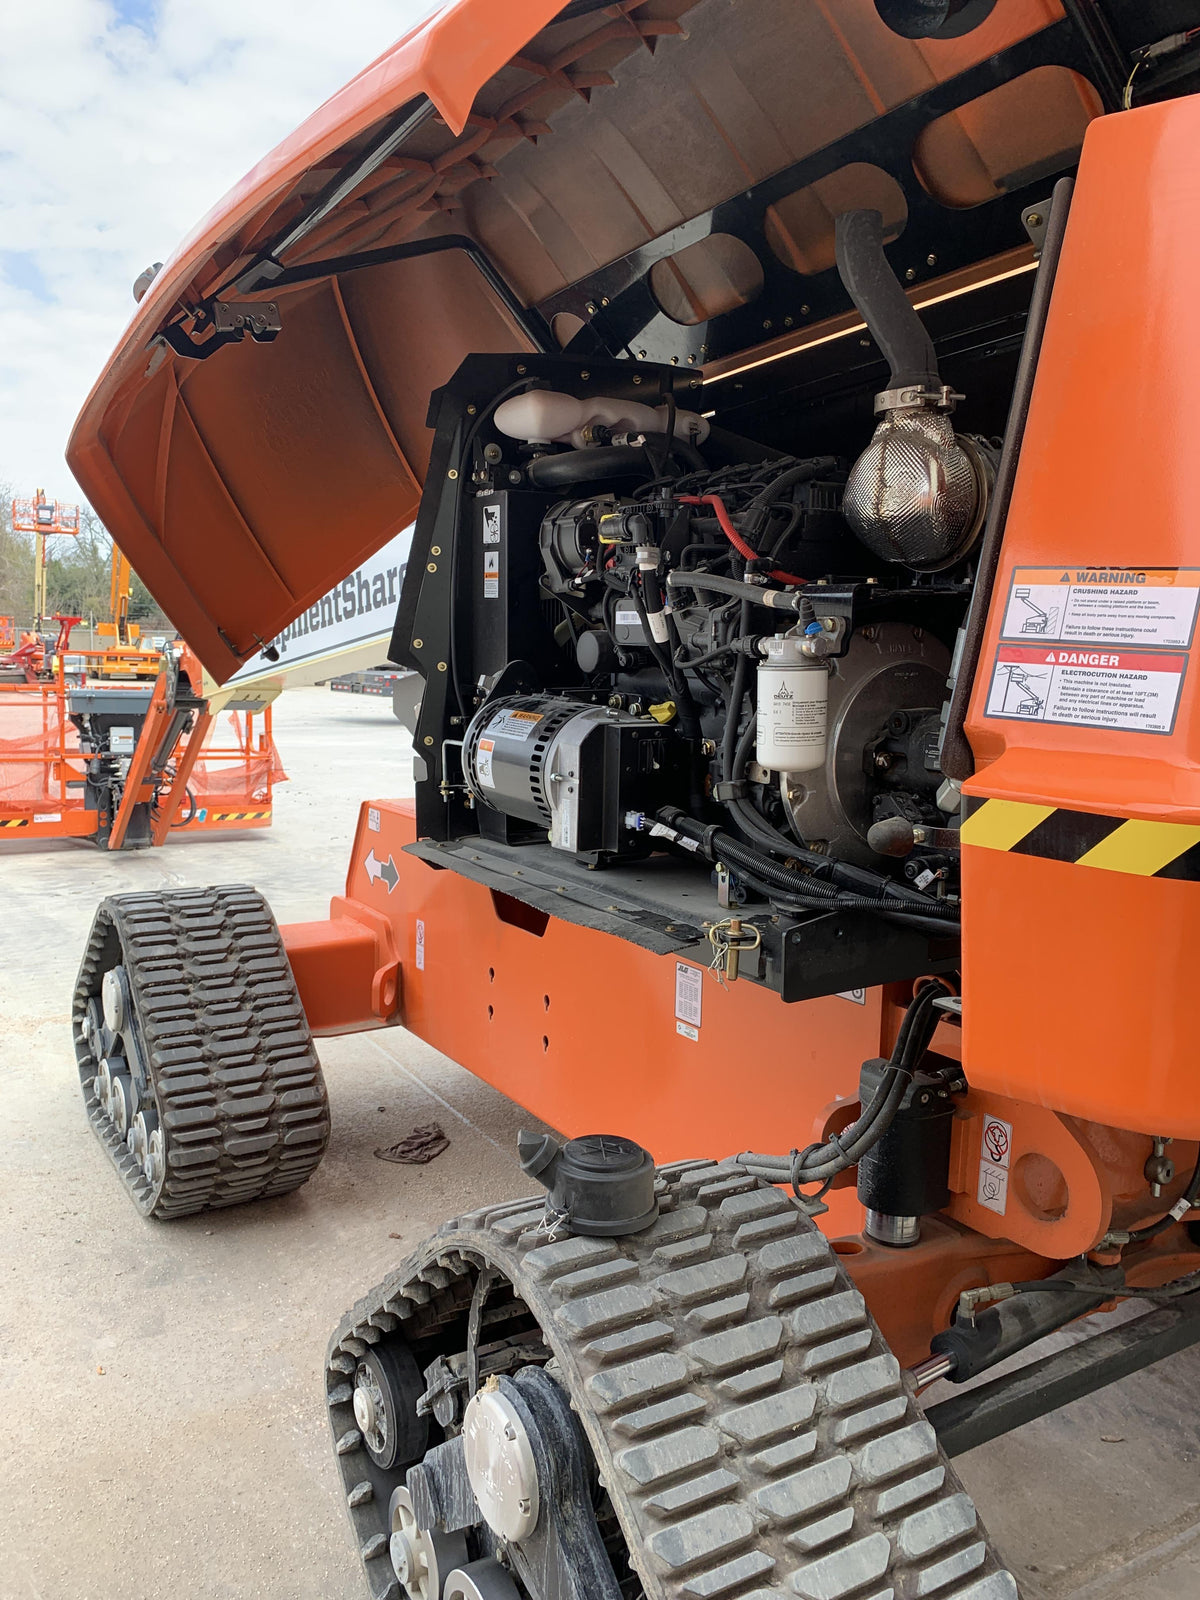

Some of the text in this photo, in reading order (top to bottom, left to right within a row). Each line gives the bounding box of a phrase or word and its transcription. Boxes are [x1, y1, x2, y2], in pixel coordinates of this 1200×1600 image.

[1076, 572, 1146, 583] WARNING
[1059, 652, 1120, 666] DANGER
[1061, 670, 1117, 678] ELECTROCUTION
[1096, 708, 1128, 716] instructions
